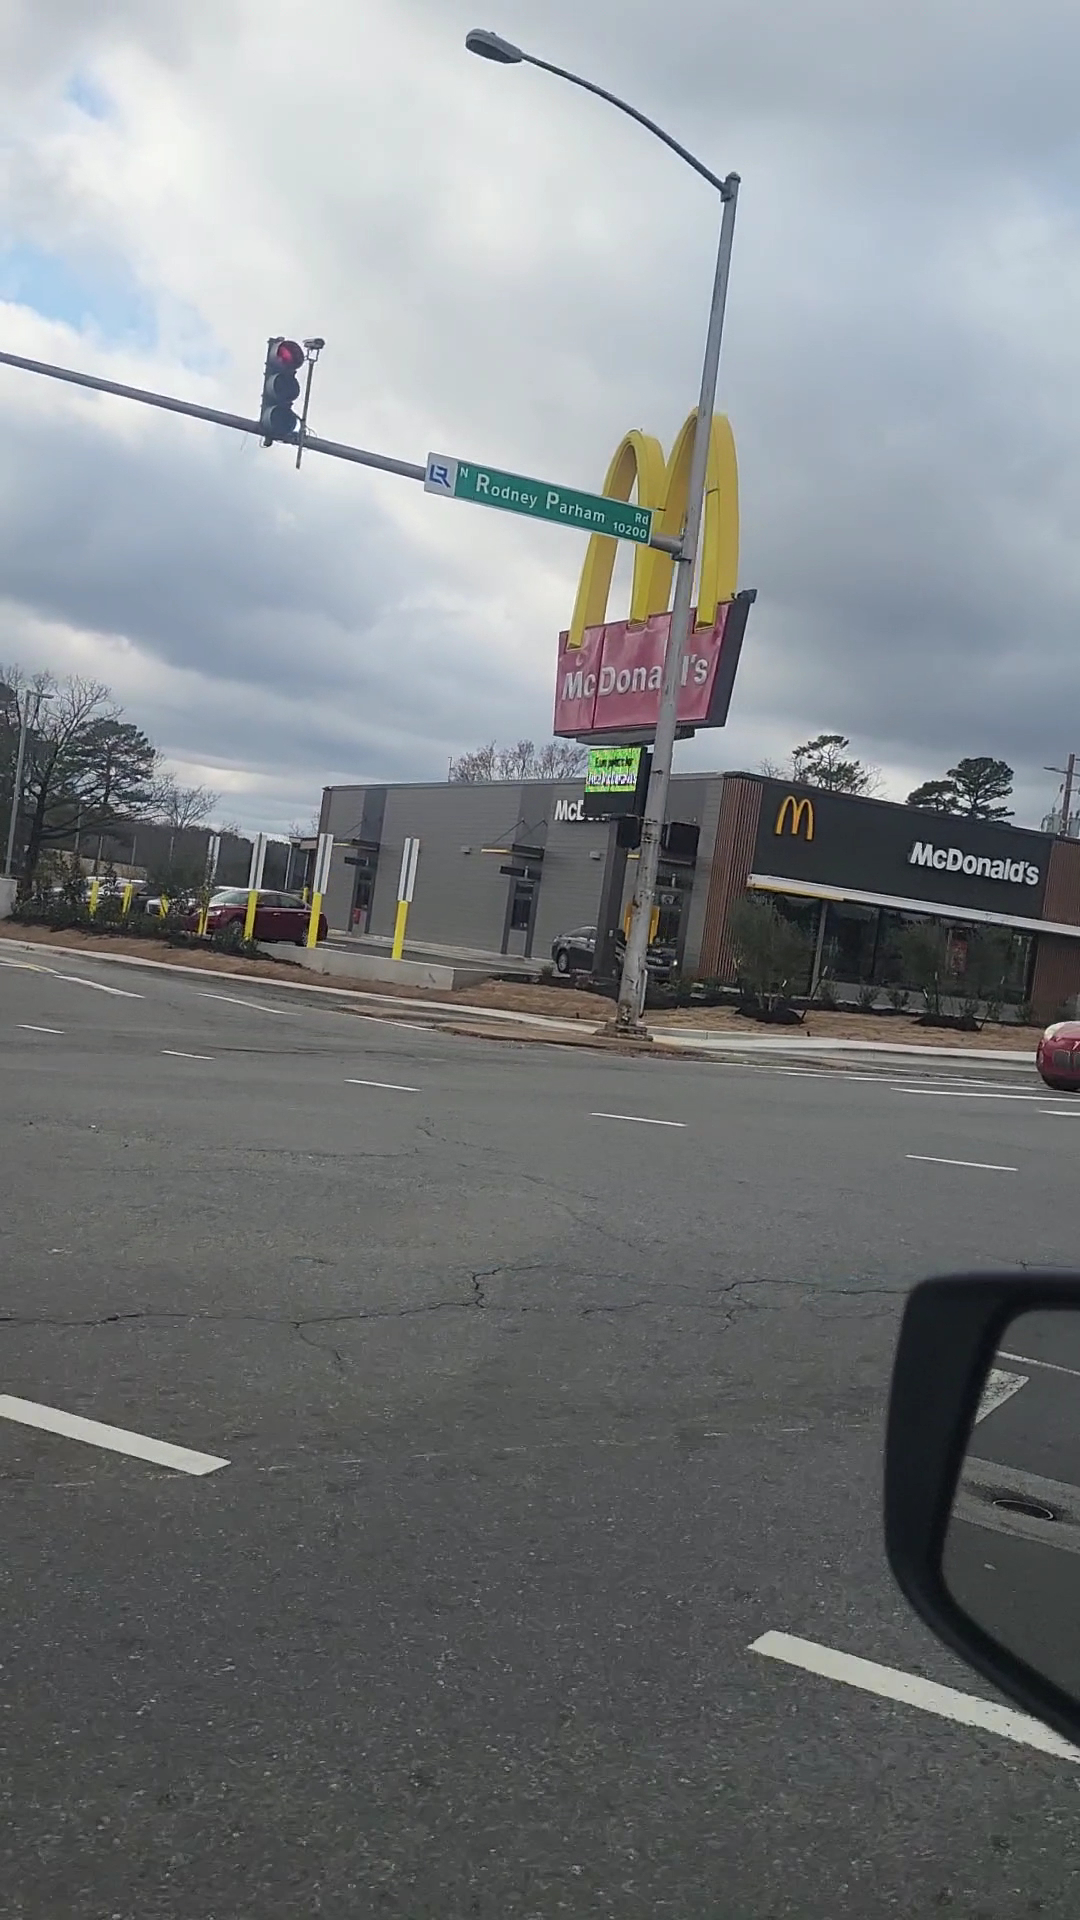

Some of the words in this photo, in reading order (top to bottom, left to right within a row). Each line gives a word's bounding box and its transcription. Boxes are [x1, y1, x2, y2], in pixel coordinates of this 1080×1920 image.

[459, 467, 469, 479] N
[475, 473, 538, 509] Rodney
[545, 491, 606, 524] Parham
[634, 512, 649, 526] Rd
[612, 521, 648, 539] 10200
[909, 841, 1040, 886] McDonald's
